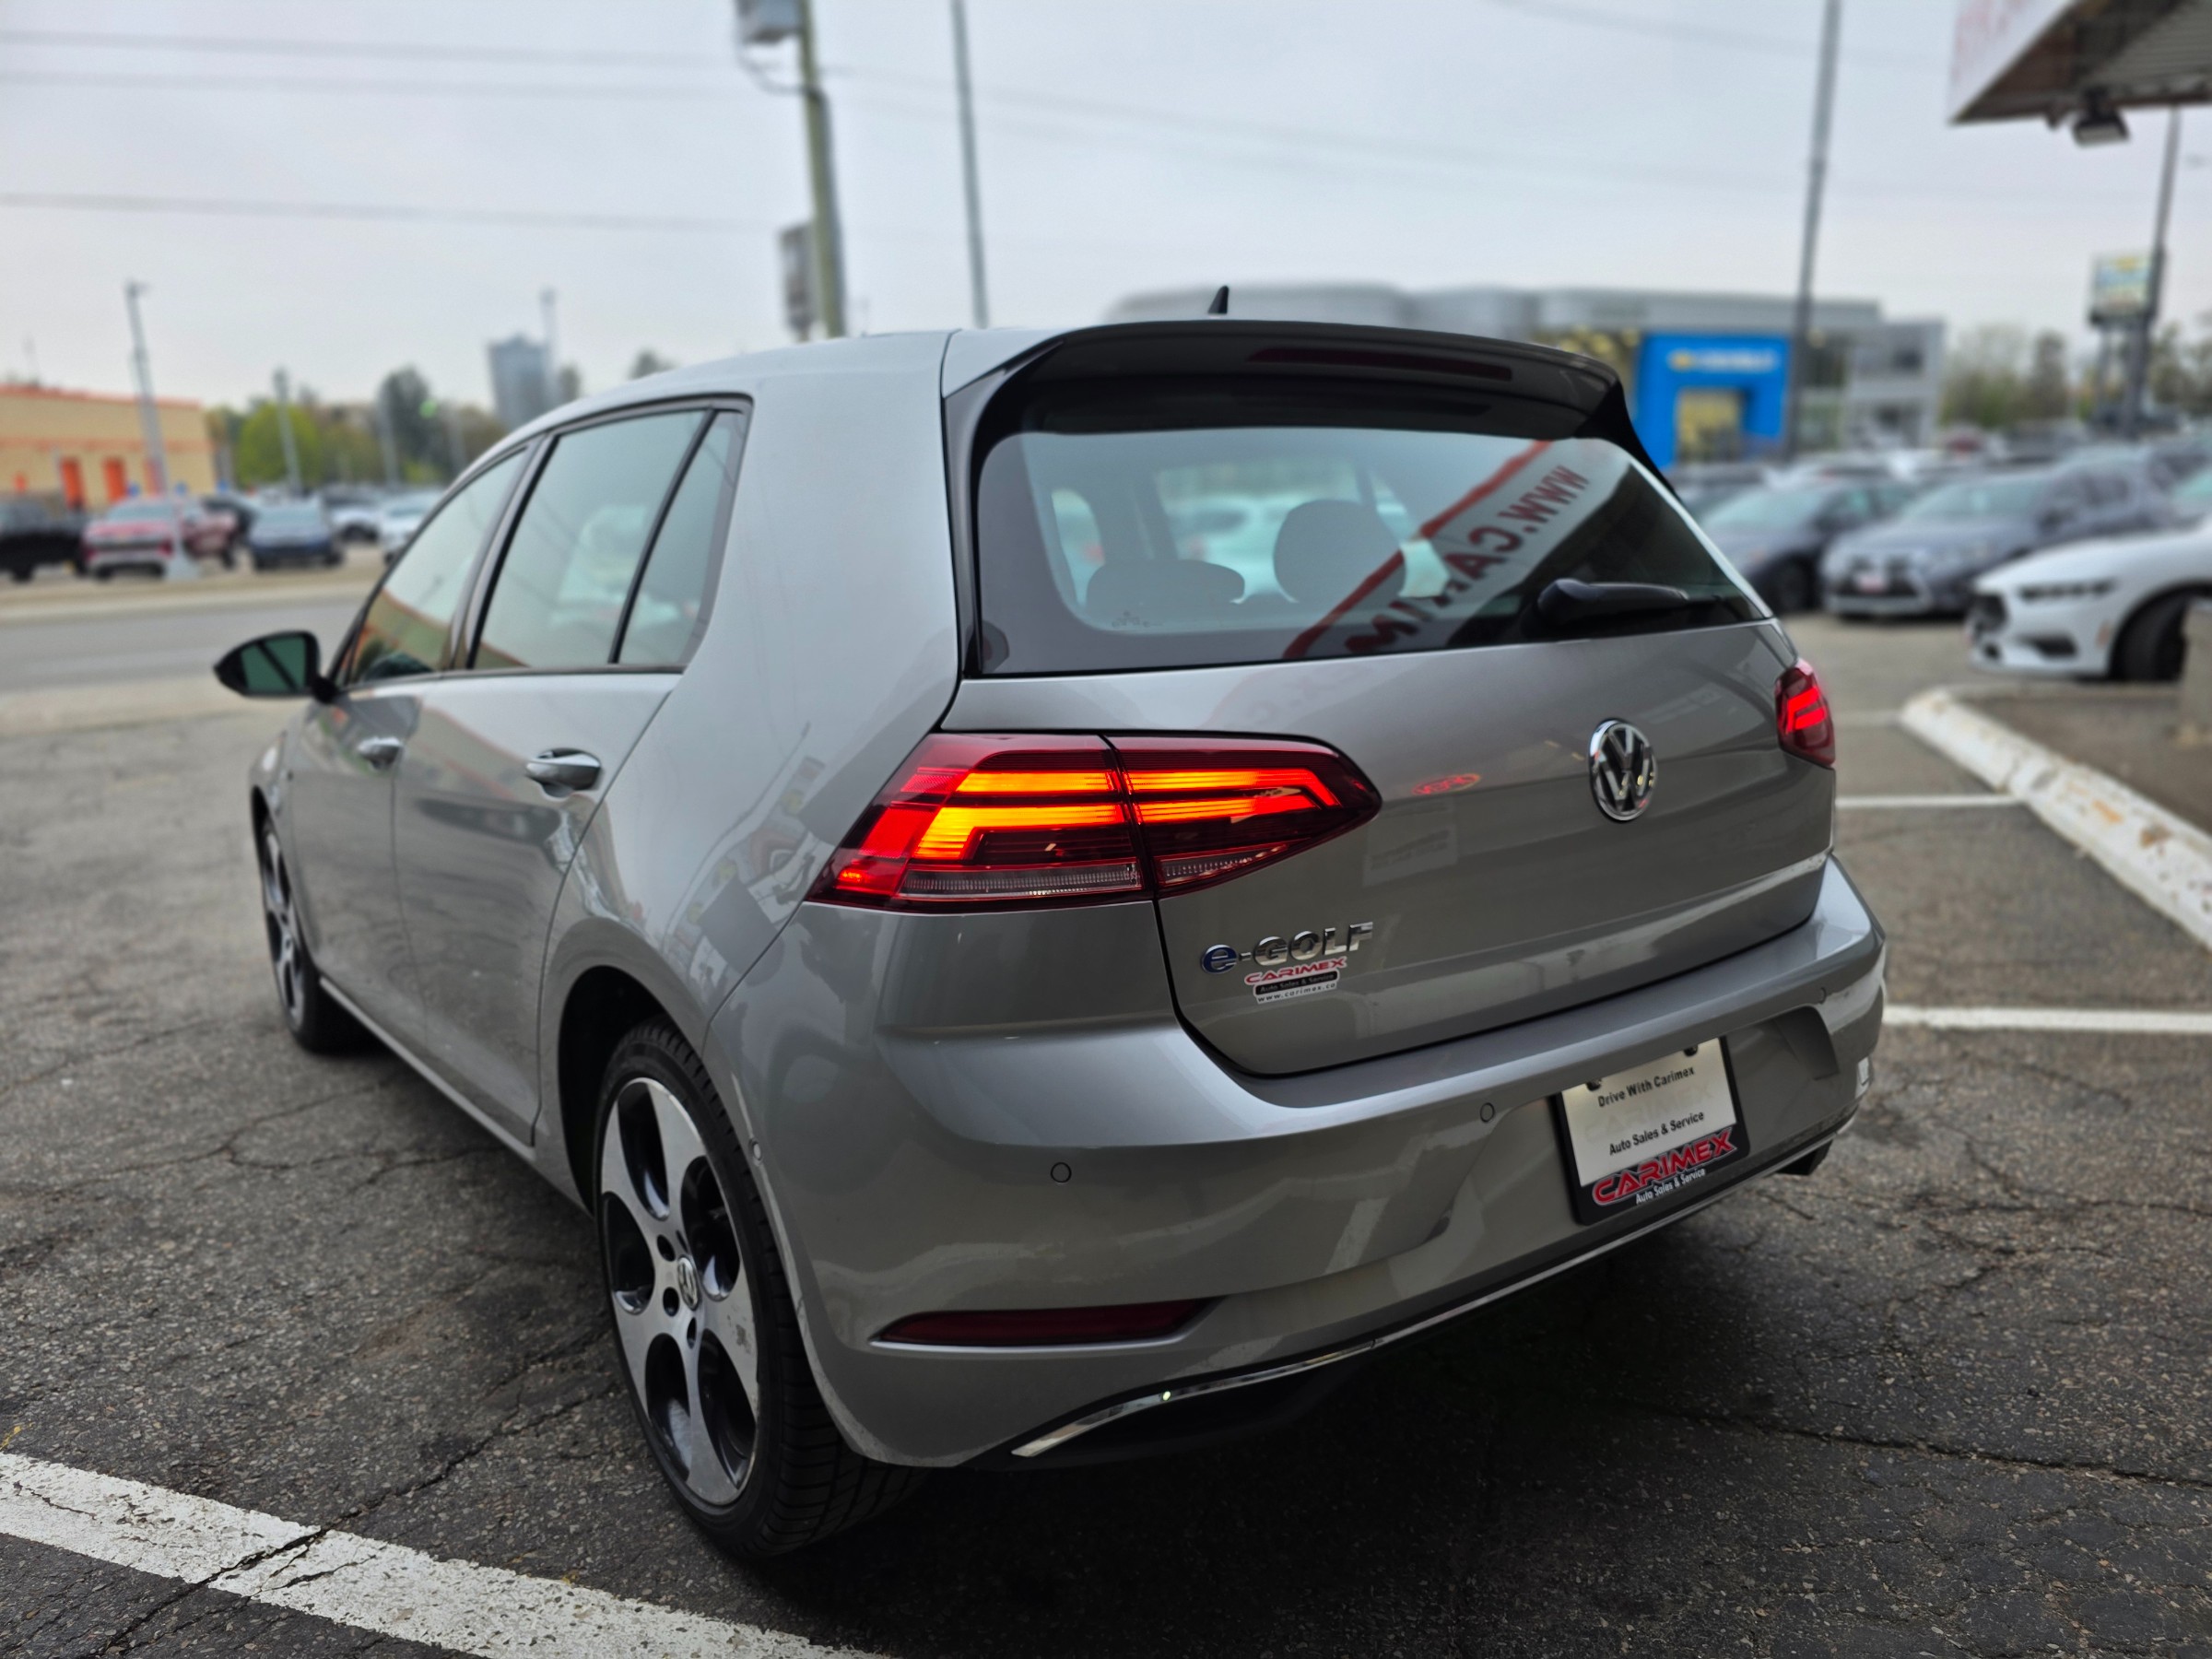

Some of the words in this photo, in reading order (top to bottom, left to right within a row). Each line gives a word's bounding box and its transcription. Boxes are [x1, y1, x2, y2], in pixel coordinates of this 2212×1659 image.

[1201, 922, 1374, 975] e-GOLF
[1245, 957, 1347, 983] CARIMEX
[1260, 984, 1278, 994] Auto
[1598, 1089, 1625, 1108] Drive
[1626, 1079, 1653, 1098] With
[1653, 1066, 1695, 1088] Carimex
[1609, 1137, 1631, 1156] Auto
[1632, 1126, 1659, 1146] Sales
[1661, 1124, 1669, 1135] &
[1670, 1111, 1704, 1132] Service
[1593, 1128, 1735, 1206] CARIMEX
[1635, 1188, 1653, 1206] Auto
[1654, 1181, 1673, 1196] Sales
[1674, 1177, 1680, 1188] &
[1680, 1168, 1705, 1185] Service
